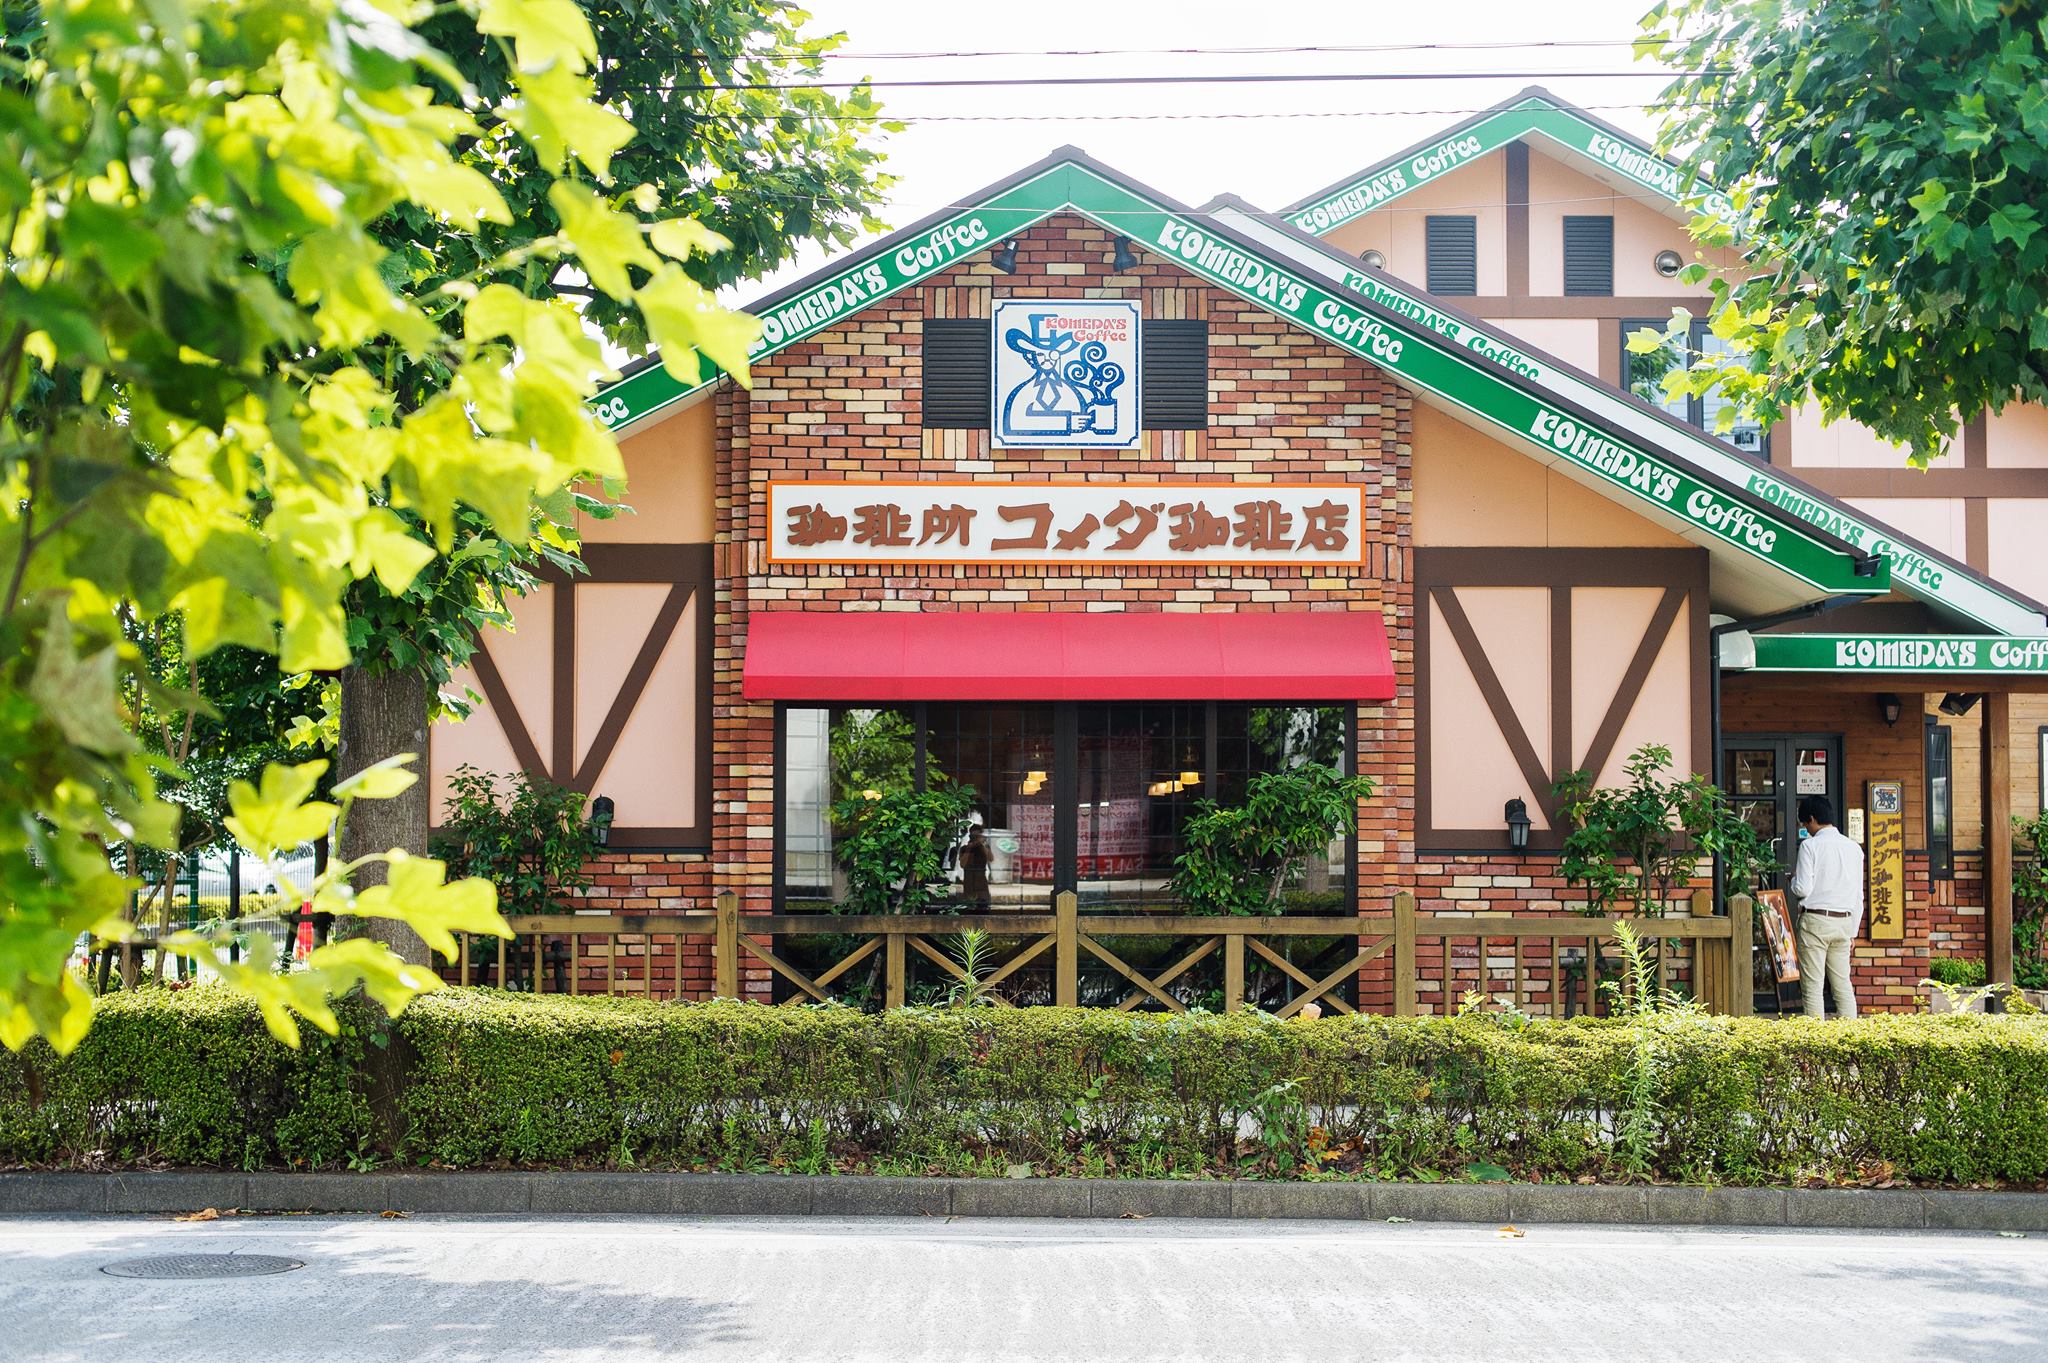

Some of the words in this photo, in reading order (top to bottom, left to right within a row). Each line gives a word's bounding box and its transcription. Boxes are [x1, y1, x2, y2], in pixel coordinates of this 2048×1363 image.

[1411, 135, 1482, 179] Coffee
[895, 218, 989, 277] Coffee
[1157, 219, 1307, 312] KOMEDA'S
[1313, 300, 1403, 363] Coffee
[1045, 317, 1127, 330] KOMEDA'S
[1073, 329, 1127, 342] Coffee
[1529, 409, 1680, 502] KOMEDA'S
[1686, 490, 1777, 553] Coffee
[1745, 474, 1865, 546] KOMEDA'S
[1836, 640, 1977, 668] KOMEDA'S
